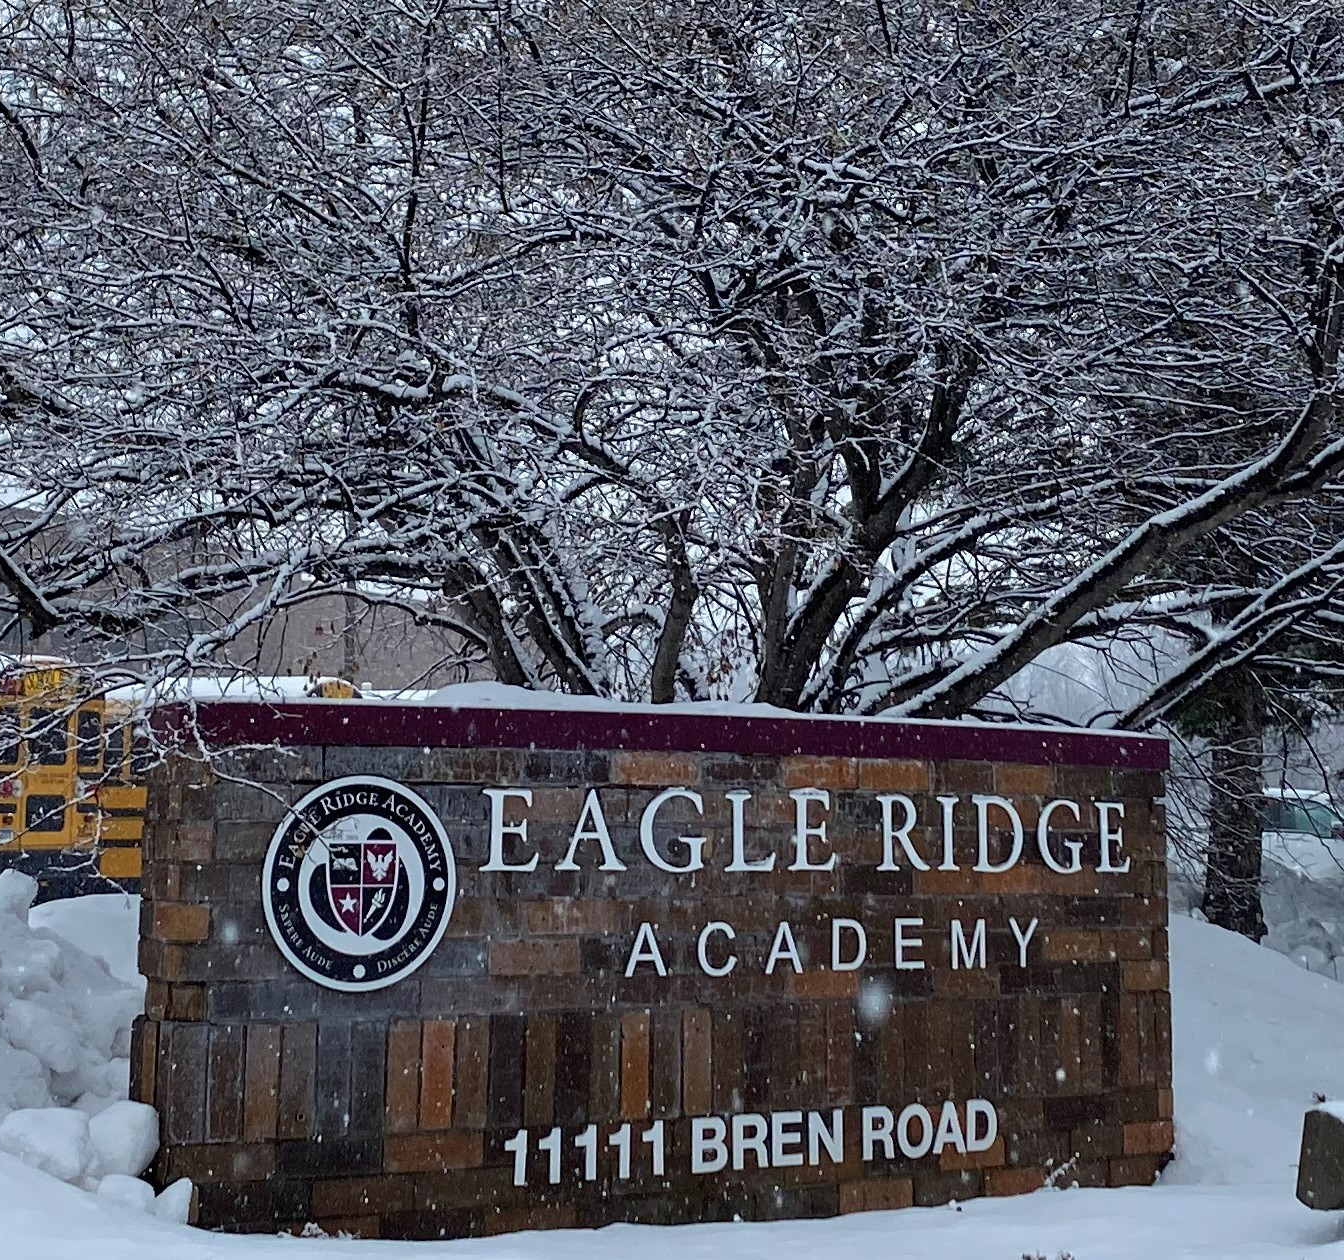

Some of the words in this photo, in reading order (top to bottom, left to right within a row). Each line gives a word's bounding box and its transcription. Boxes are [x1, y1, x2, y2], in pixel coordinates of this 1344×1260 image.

[381, 793, 442, 872] ACADEMY
[479, 787, 838, 873] EAGLE
[875, 794, 1133, 874] RIDGE
[419, 902, 439, 939] AUDE
[624, 917, 1039, 978] ACADEMY
[301, 945, 333, 970] AUDE
[505, 1119, 665, 1187] 11111
[691, 1107, 846, 1176] BREN
[862, 1099, 999, 1162] ROAD
